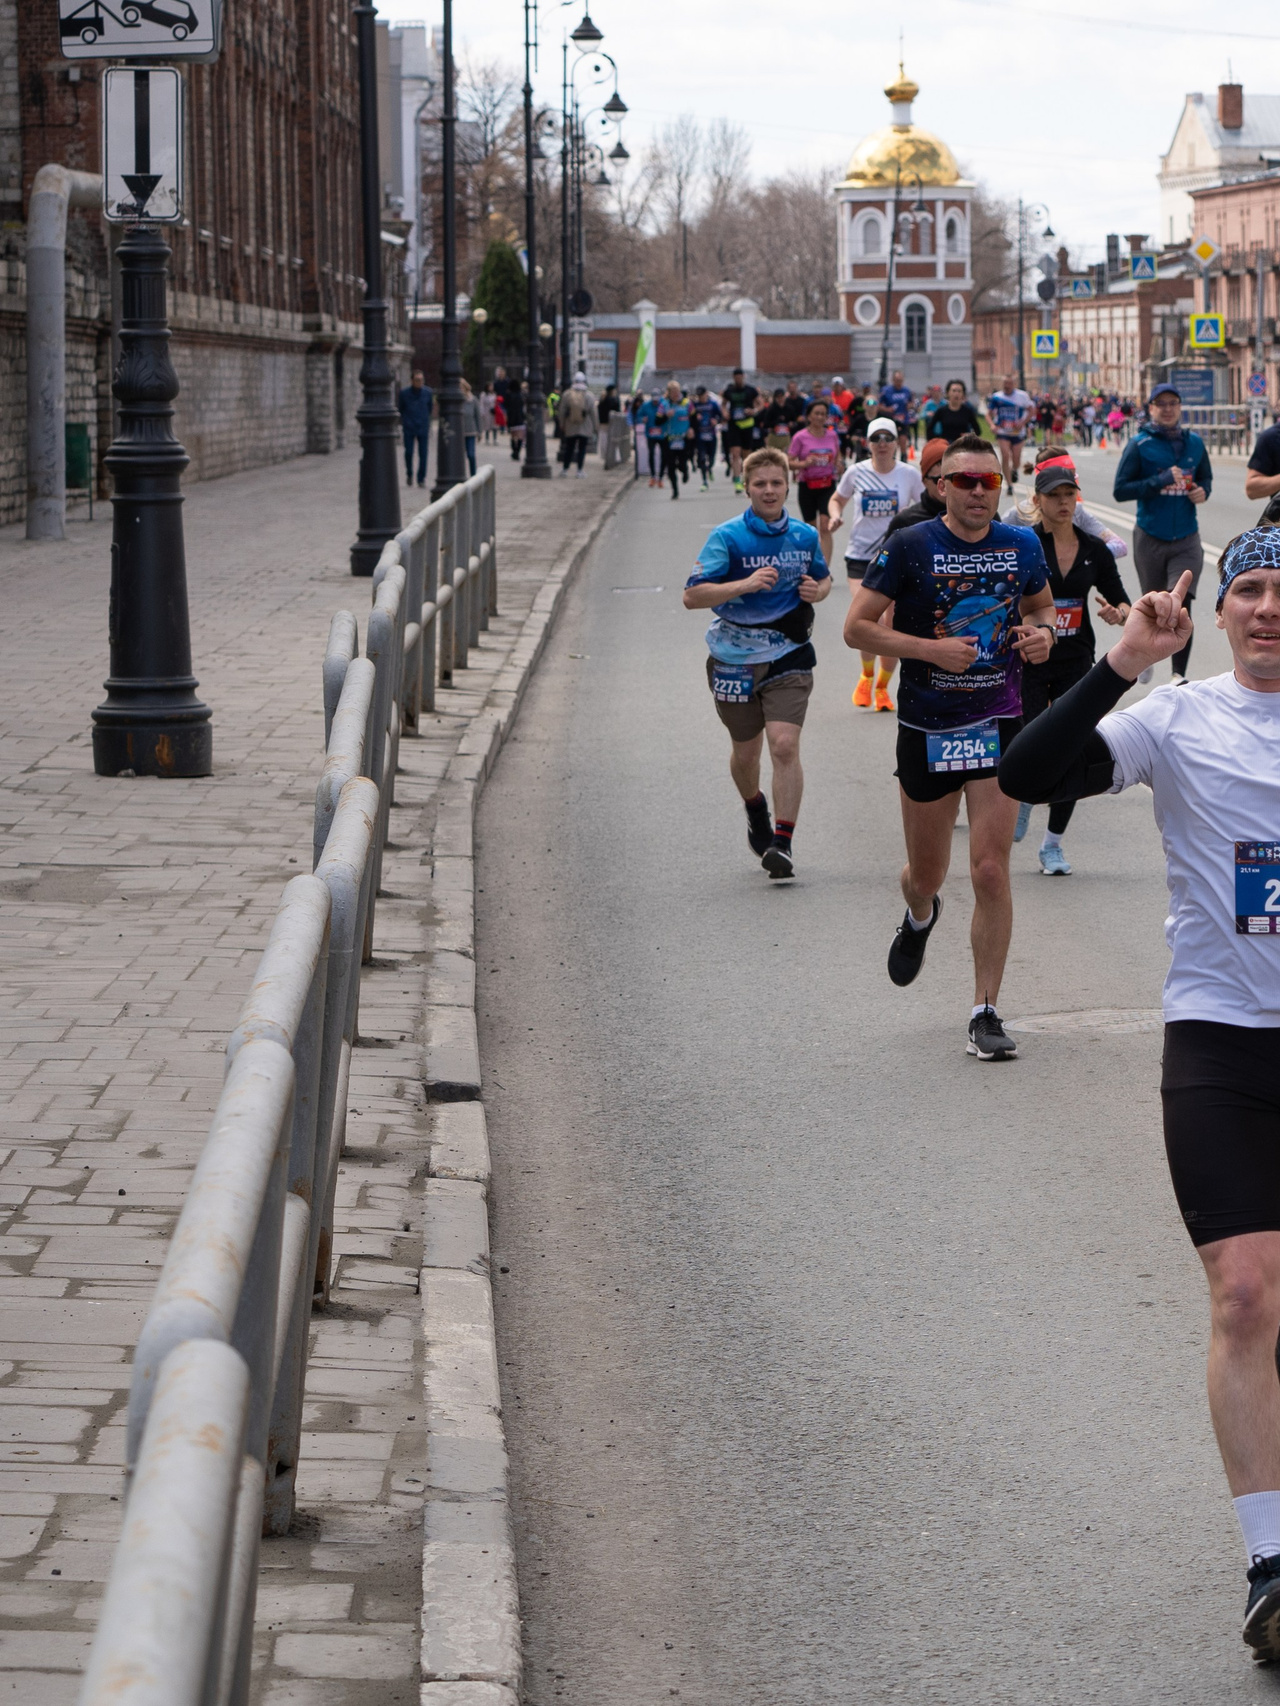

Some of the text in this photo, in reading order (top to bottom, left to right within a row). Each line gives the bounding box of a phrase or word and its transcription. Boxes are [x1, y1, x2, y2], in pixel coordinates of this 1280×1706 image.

[868, 500, 892, 511] 2300
[742, 555, 781, 568] LUKA
[779, 551, 812, 562] ULTRA
[933, 552, 1017, 563] Я ПРОСТО
[934, 561, 1019, 574] КОСМОС
[1056, 613, 1072, 628] 47
[714, 677, 742, 694] 2273
[942, 739, 986, 760] 2254
